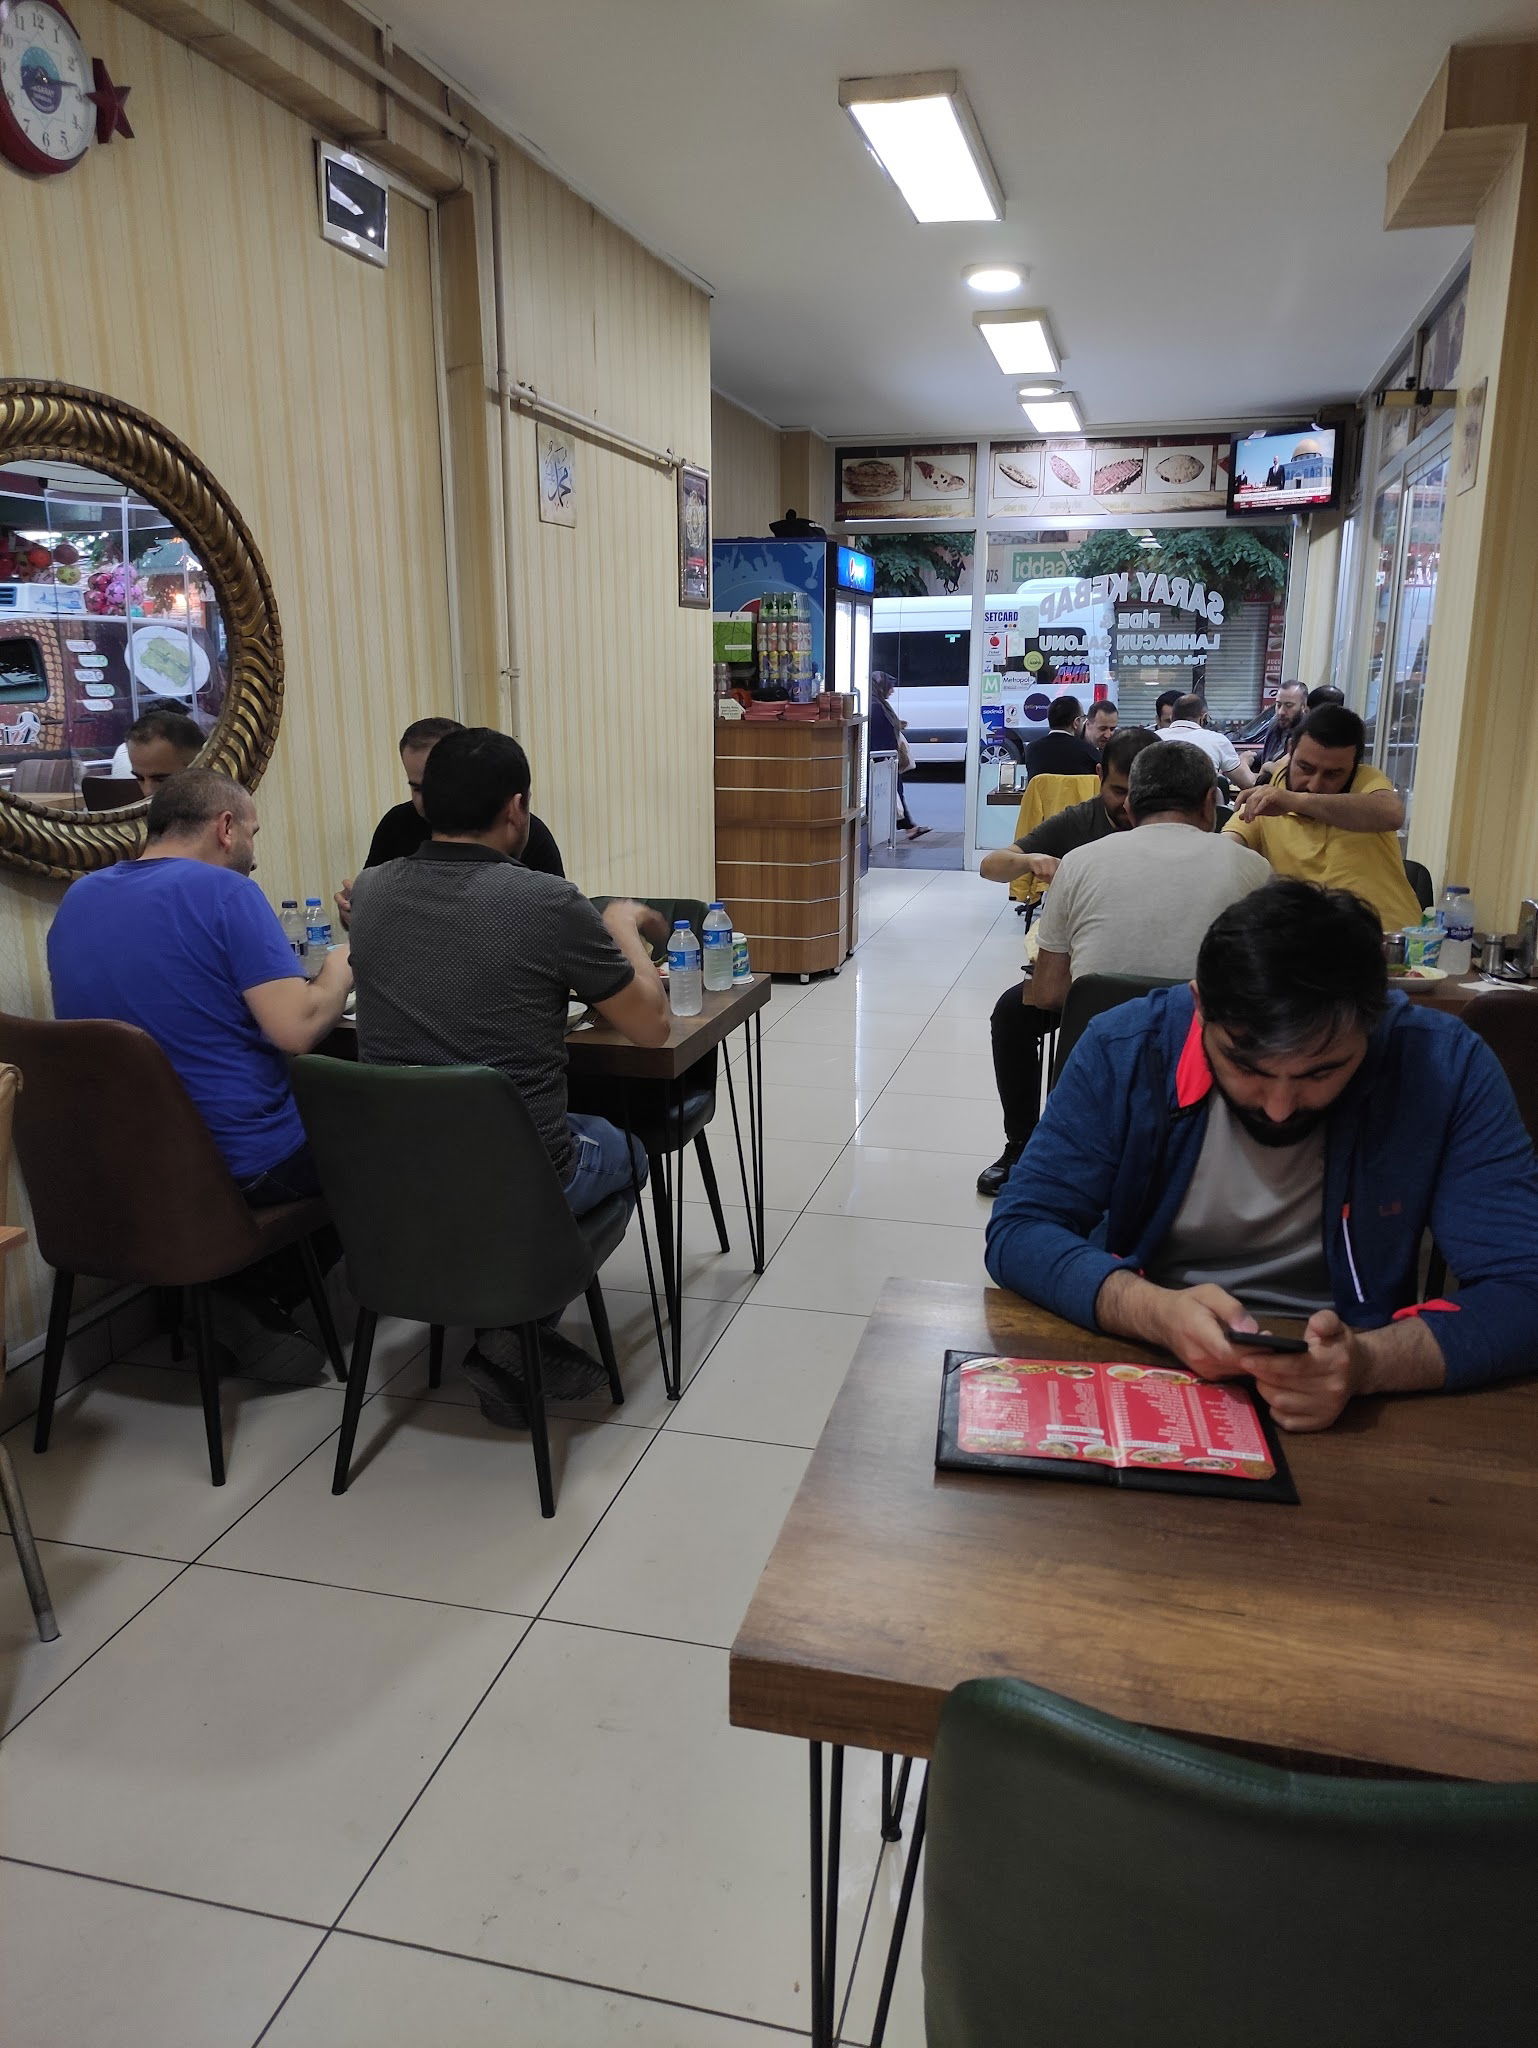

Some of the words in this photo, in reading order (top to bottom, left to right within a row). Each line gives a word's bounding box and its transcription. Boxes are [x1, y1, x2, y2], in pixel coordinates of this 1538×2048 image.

[15, 14, 25, 31] 11
[32, 12, 45, 31] 12
[3, 33, 14, 50] 10
[53, 28, 59, 44] 1
[67, 55, 75, 72] 2
[7, 90, 15, 107] 8
[23, 118, 31, 134] 7
[42, 132, 51, 147] 6
[60, 131, 69, 147] 5
[1015, 556, 1067, 579] iddaa
[984, 611, 1019, 622] SETCARD
[984, 678, 999, 691] M
[1003, 676, 1030, 684] Metropol
